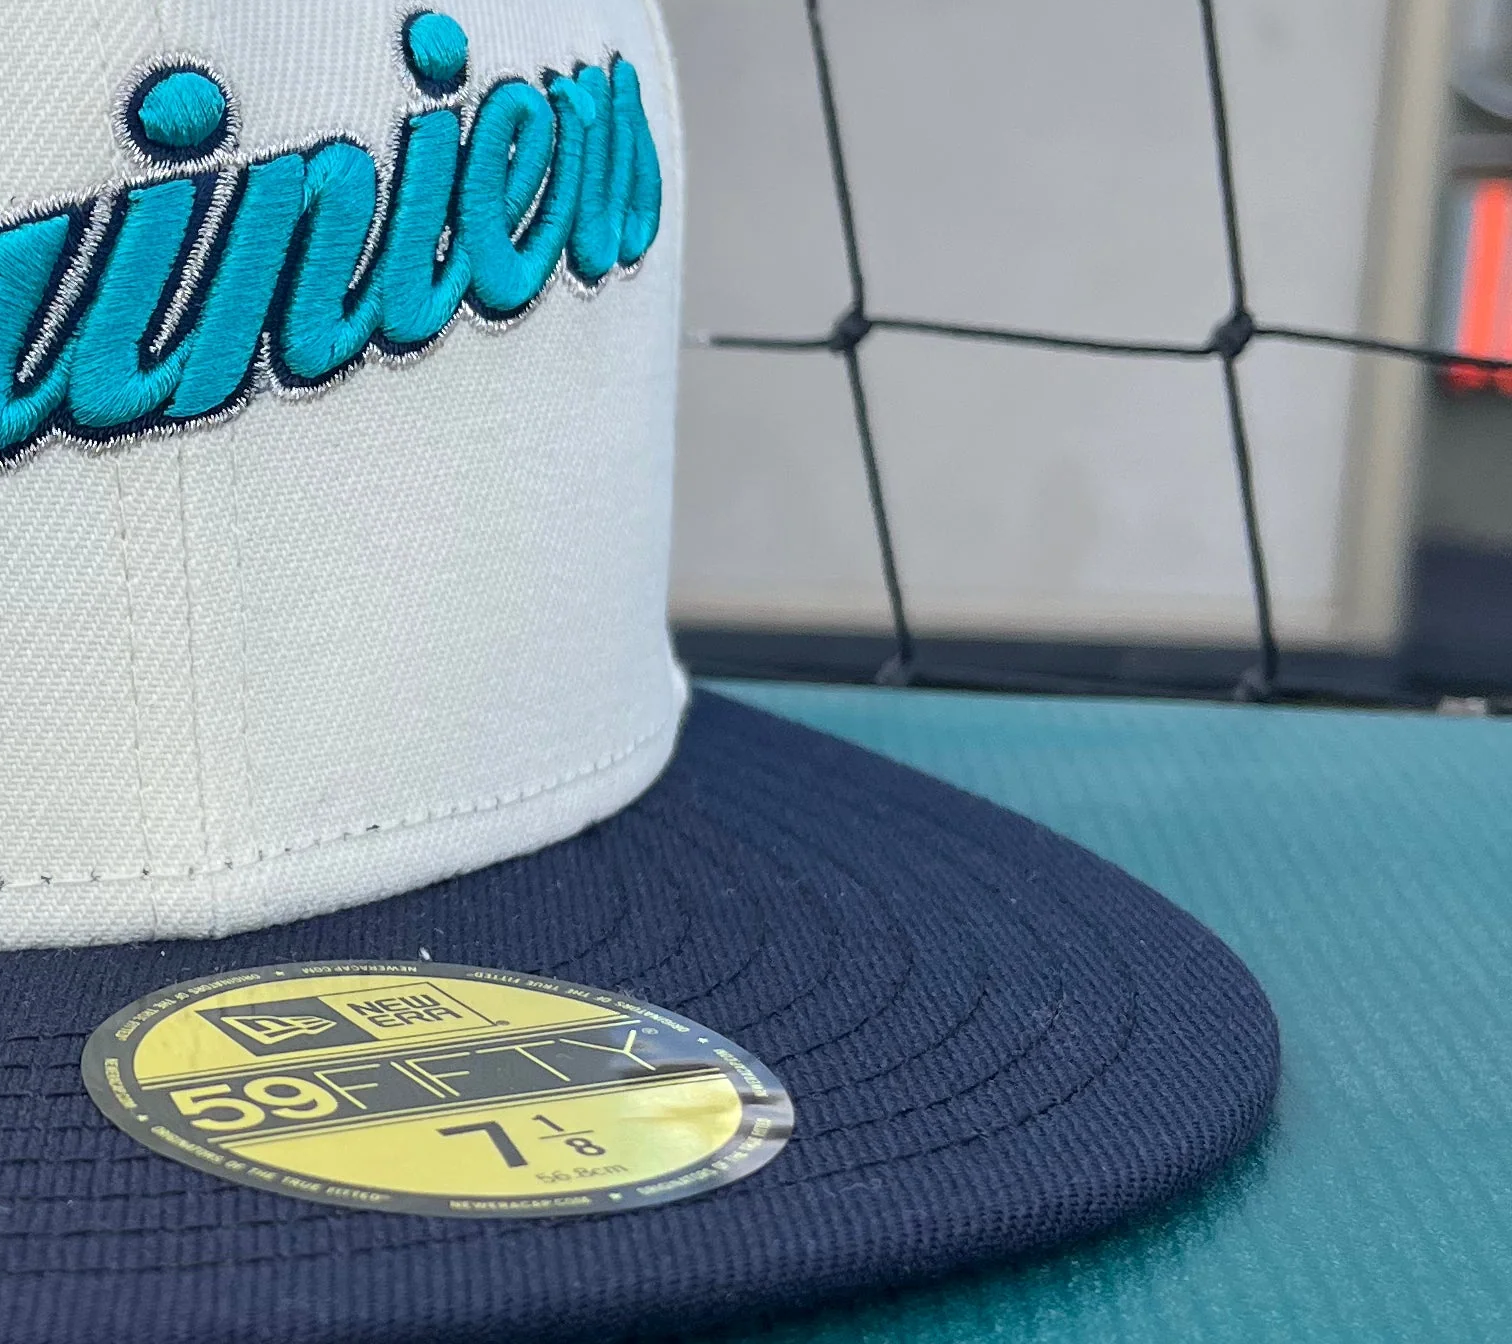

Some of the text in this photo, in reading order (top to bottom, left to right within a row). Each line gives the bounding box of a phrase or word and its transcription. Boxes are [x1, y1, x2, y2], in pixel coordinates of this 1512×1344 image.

[346, 993, 441, 1016] NEW
[367, 1007, 464, 1028] ERA
[435, 1120, 529, 1168] 7
